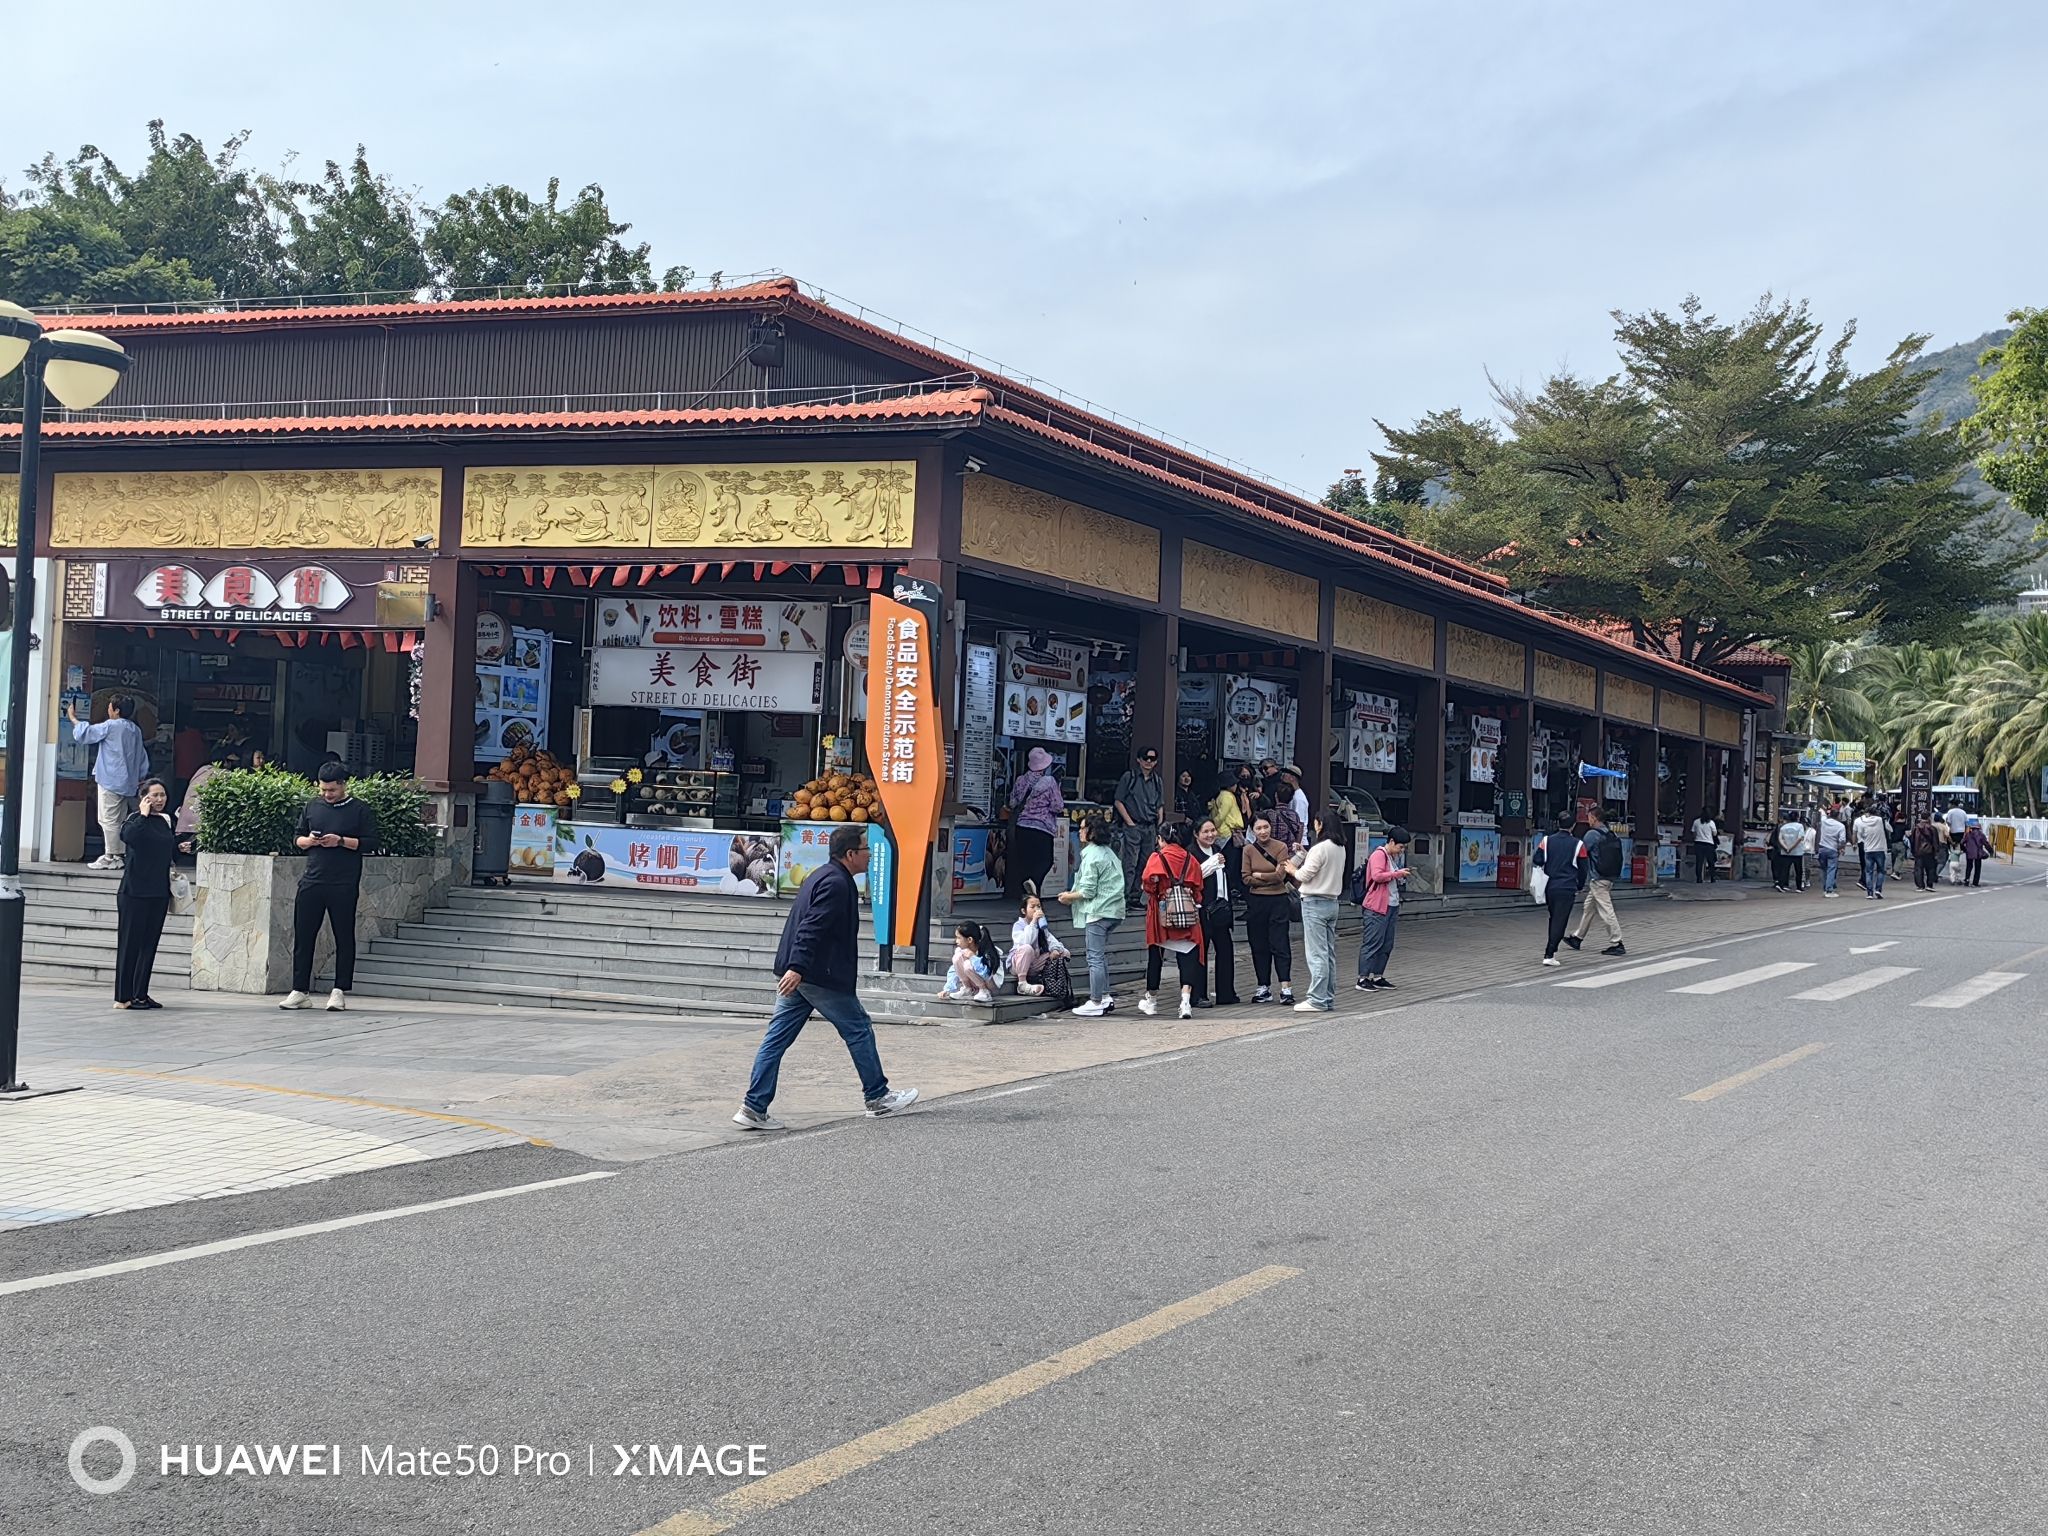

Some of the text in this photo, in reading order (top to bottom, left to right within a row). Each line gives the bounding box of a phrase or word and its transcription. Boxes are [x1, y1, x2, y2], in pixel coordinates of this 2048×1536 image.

[155, 566, 327, 606] 美食街
[161, 609, 312, 622] STREET OF DELICACIES
[658, 603, 763, 630] 饮料·雪糕
[649, 651, 762, 690] 美食街
[631, 691, 778, 709] STREET OF DELICACIES
[881, 617, 896, 782] Food Safety Demonstration Street
[891, 617, 920, 784] 食品安全示范街
[511, 812, 546, 828] 金椰
[628, 842, 708, 870] 烤椰子
